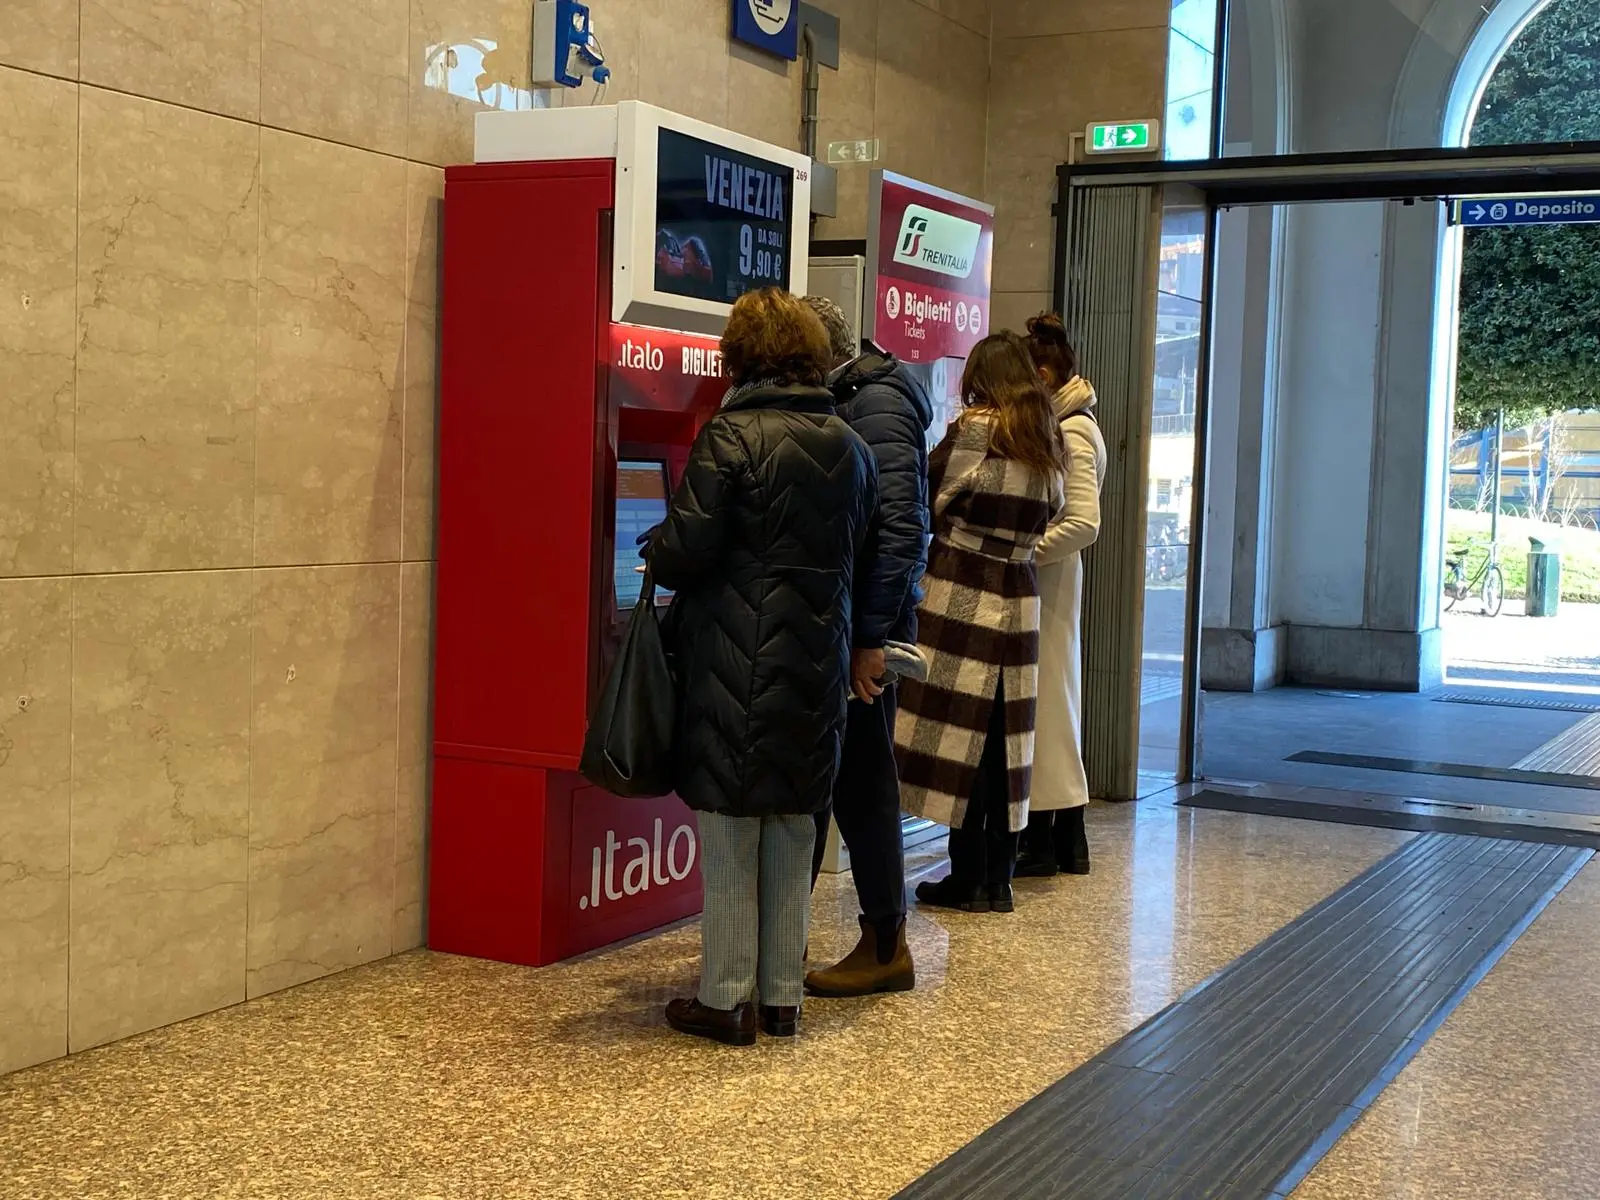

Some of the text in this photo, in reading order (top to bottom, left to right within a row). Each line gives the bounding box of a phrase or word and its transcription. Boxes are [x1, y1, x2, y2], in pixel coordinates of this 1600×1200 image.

[704, 154, 784, 222] VENEZIA
[1515, 200, 1595, 218] Deposito
[768, 230, 783, 248] SOLI
[774, 253, 782, 281] €
[922, 247, 969, 271] TRENITALIA
[904, 291, 952, 324] Biglietti
[904, 320, 926, 340] Tickets
[681, 346, 722, 378] BIGLIET
